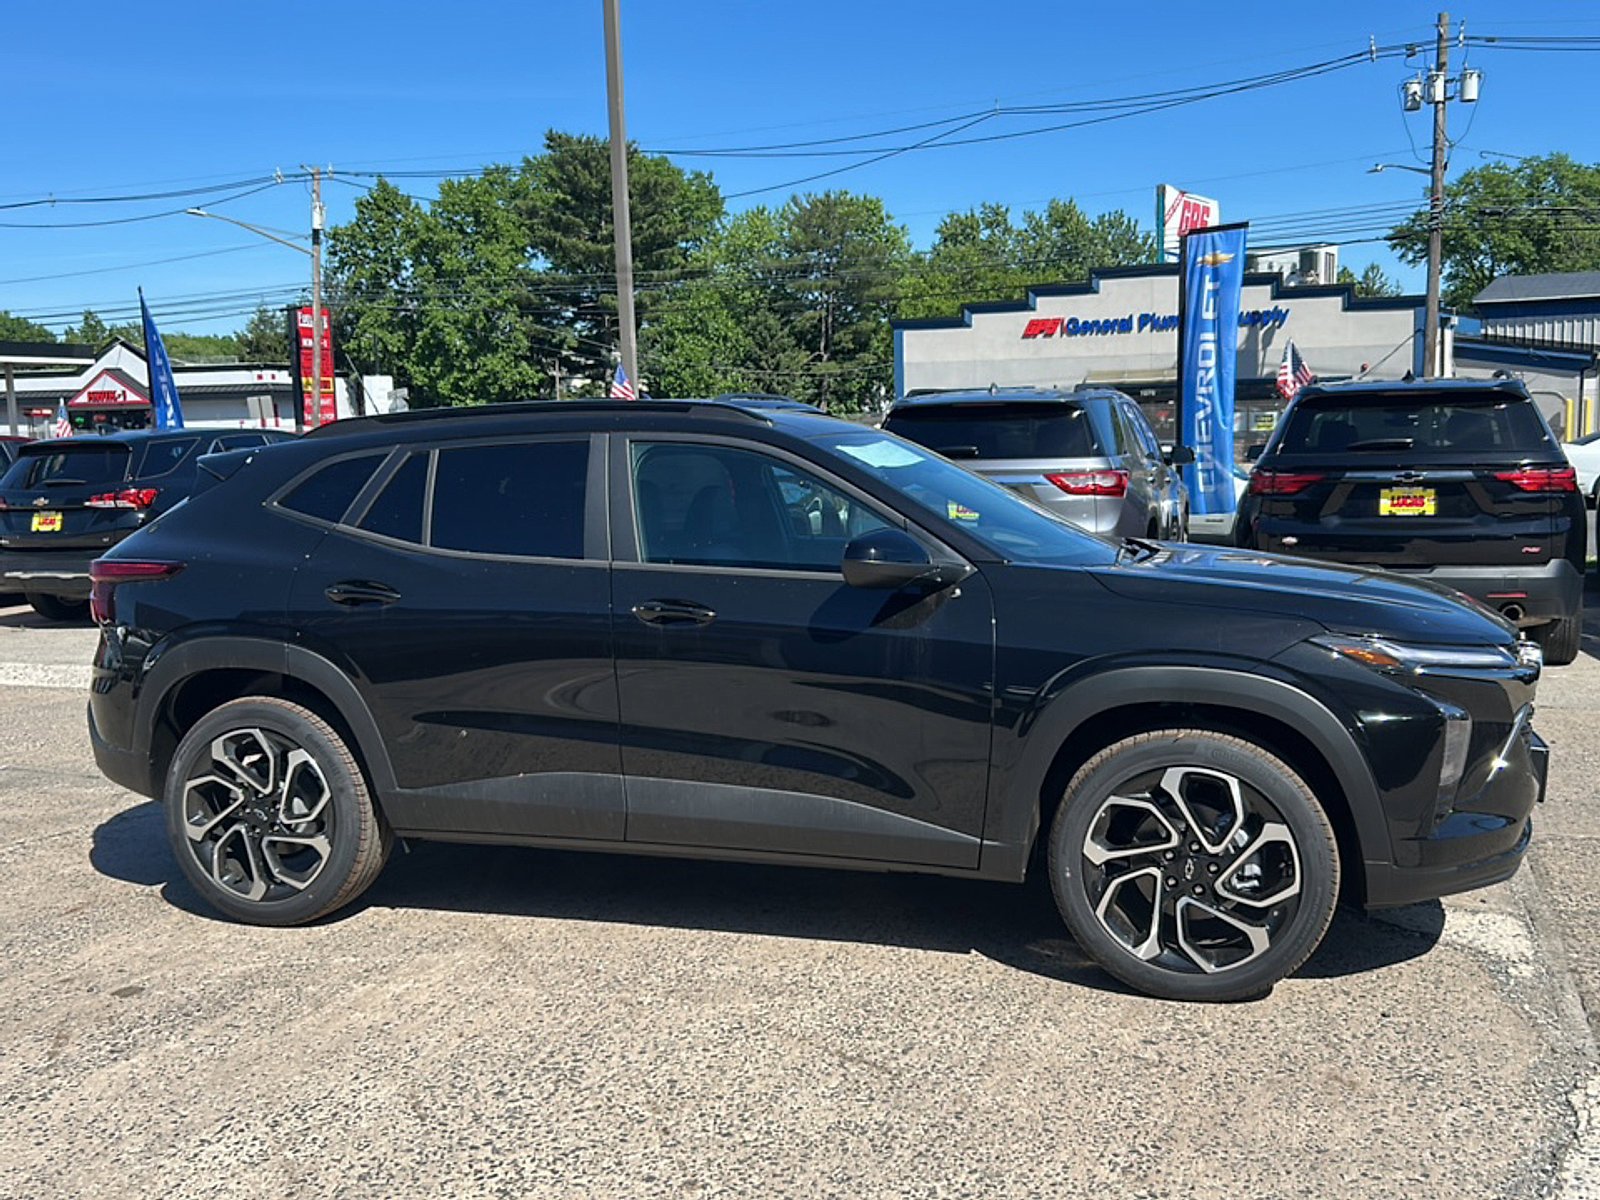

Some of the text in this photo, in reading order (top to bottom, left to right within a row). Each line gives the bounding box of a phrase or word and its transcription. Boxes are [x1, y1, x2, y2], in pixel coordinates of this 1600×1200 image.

[1177, 199, 1210, 237] GPS
[1065, 315, 1133, 337] General
[1138, 311, 1180, 333] Plum
[1238, 305, 1289, 330] upply
[1195, 273, 1221, 493] CHEVROLET
[1390, 495, 1425, 507] LUCAS
